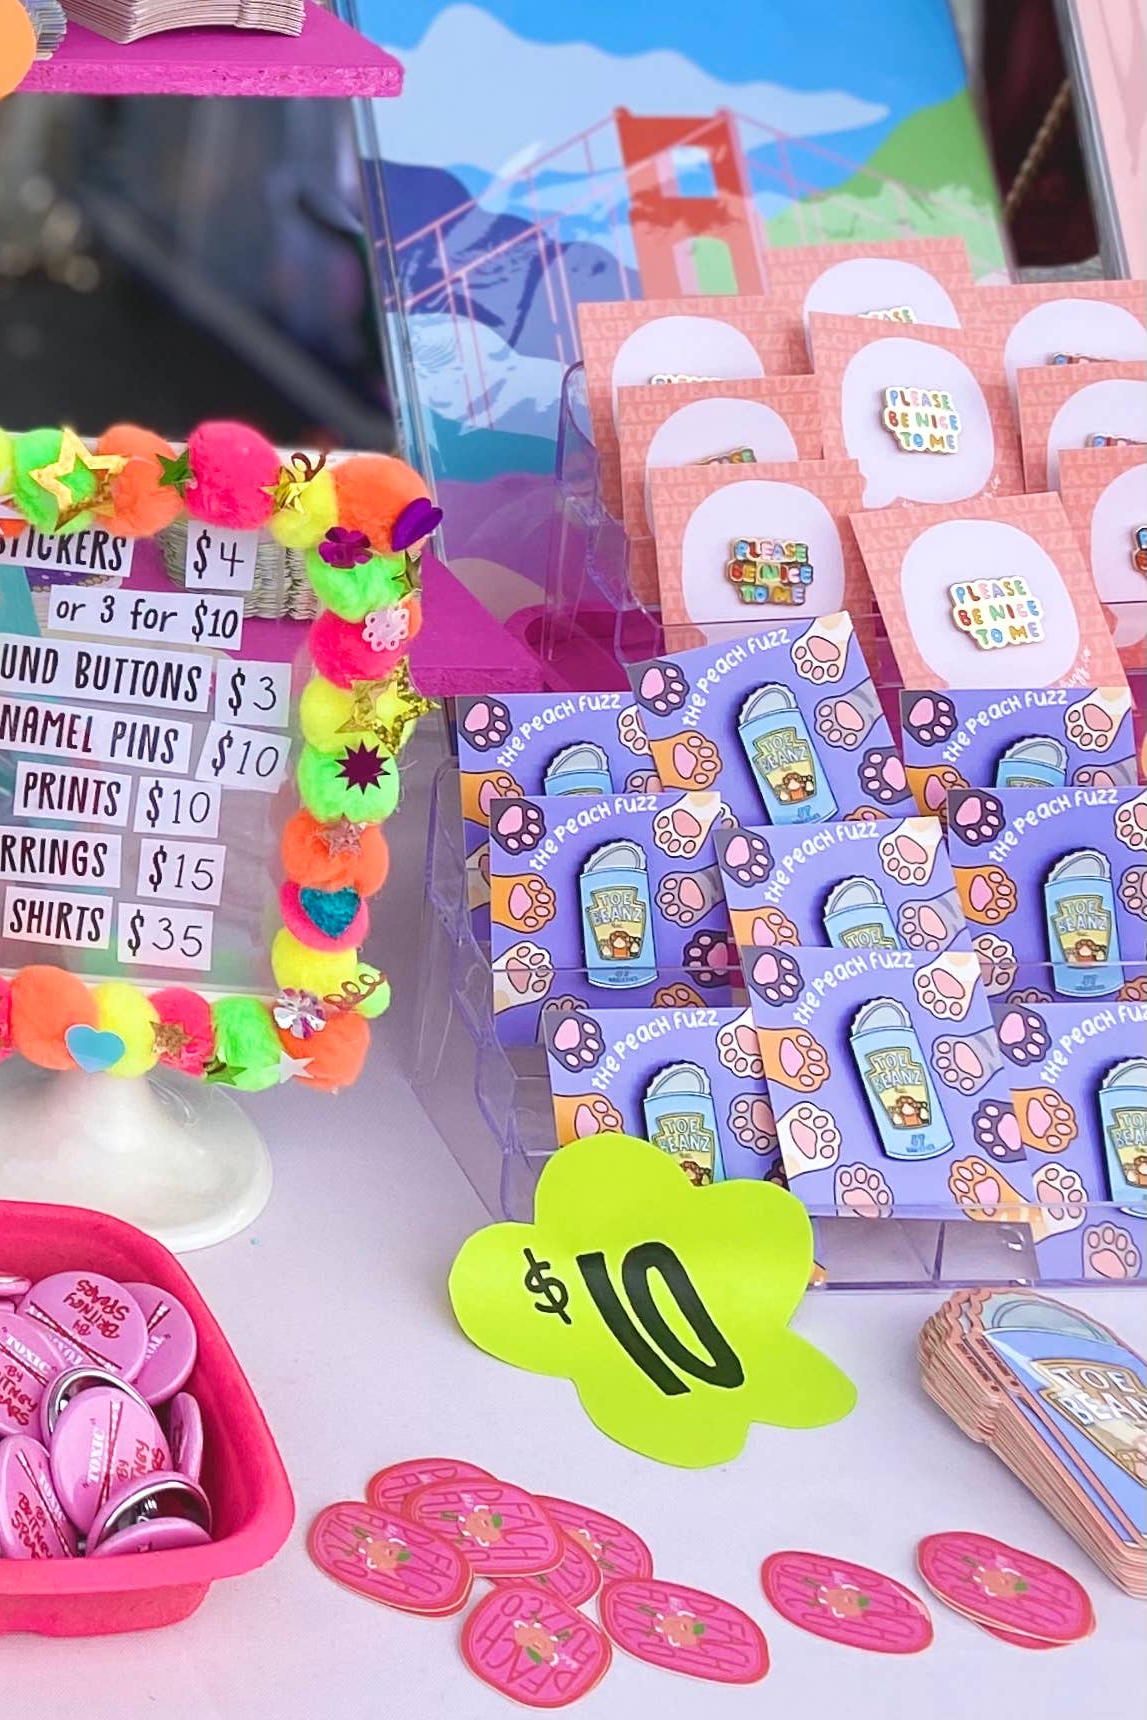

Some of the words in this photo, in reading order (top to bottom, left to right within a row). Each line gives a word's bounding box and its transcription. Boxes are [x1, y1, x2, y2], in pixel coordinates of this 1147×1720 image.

[889, 390, 952, 410] PLEASE
[888, 413, 910, 428] BE
[915, 411, 959, 431] NICE
[900, 431, 924, 448] TO
[929, 434, 956, 451] ME
[735, 540, 809, 561] PLEASE
[730, 566, 756, 583] BE
[759, 563, 814, 584] NICE
[740, 584, 769, 603] TO
[773, 585, 806, 604] ME
[955, 579, 1028, 604] PLEASE
[56, 596, 86, 622] or
[100, 594, 115, 624] 3
[130, 598, 178, 632] for
[192, 599, 239, 642] $10
[957, 608, 985, 627] BE
[988, 600, 1040, 622] NICE
[975, 627, 1004, 646] TO
[1009, 621, 1041, 640] ME
[75, 651, 202, 702] BUTTONS
[110, 720, 179, 766] PINS
[211, 731, 279, 778] $10
[22, 771, 121, 818] PRINTS
[146, 780, 211, 828] $10
[149, 845, 215, 893] $15
[9, 897, 104, 944] SHIRTS
[128, 909, 204, 958] $35
[1117, 1004, 1147, 1023] FUZ
[1120, 1112, 1147, 1129] TO
[1112, 1128, 1147, 1148] BEA
[1050, 1367, 1137, 1395] TOE
[1057, 1391, 1147, 1426] BEAN
